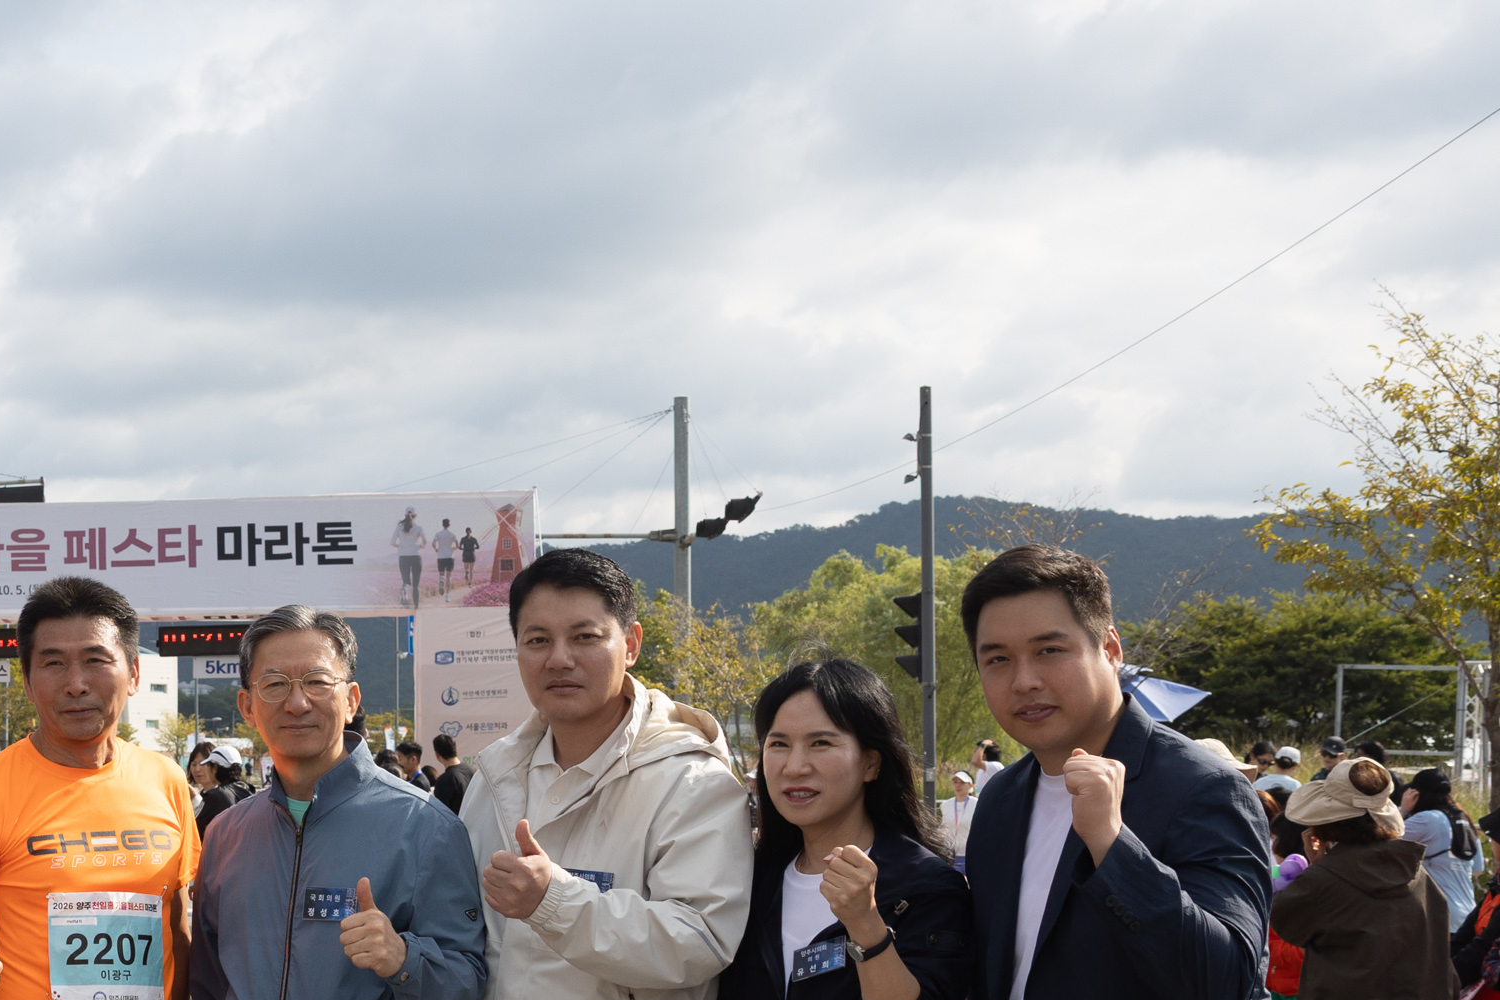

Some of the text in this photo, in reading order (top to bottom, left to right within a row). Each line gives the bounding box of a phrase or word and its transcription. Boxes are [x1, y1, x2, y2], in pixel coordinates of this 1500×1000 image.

[63, 525, 203, 571] 페스타
[216, 521, 358, 567] 마라톤
[16, 585, 26, 595] 5.
[51, 852, 163, 869] SPORTS
[52, 902, 74, 910] 2026
[76, 901, 91, 910] 양주
[92, 901, 114, 911] 천일홍
[115, 902, 127, 911] 가을
[128, 903, 145, 912] 페스타
[65, 932, 153, 966] 2207
[101, 969, 132, 981] 이광구
